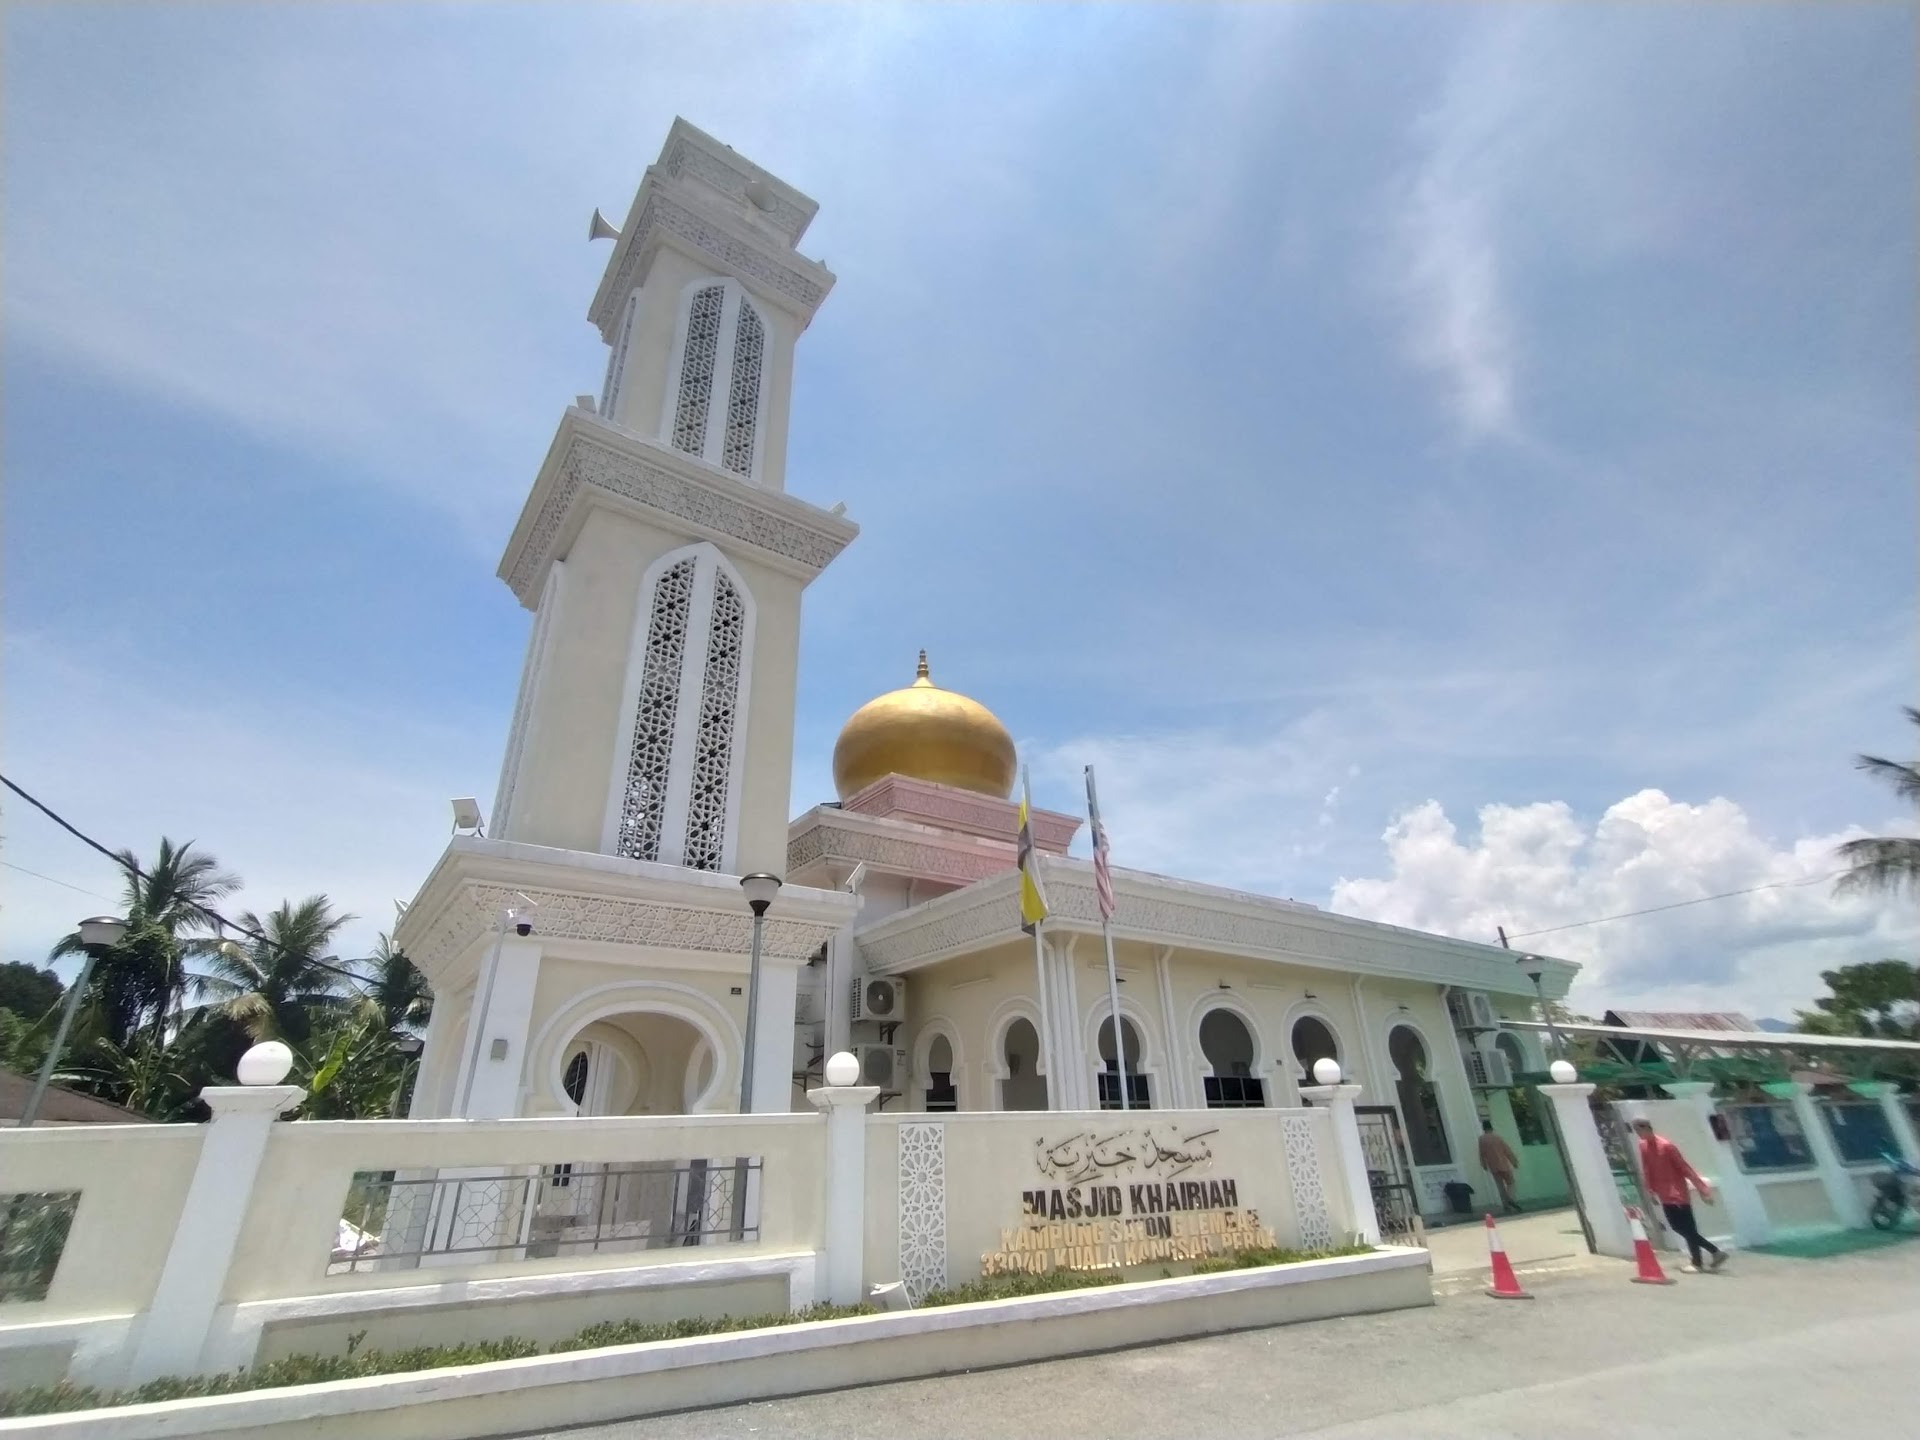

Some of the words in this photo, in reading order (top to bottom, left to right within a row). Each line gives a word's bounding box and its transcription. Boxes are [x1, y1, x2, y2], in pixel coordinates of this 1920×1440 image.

[1023, 1185, 1122, 1220] MASJID
[1130, 1179, 1238, 1214] KHAIRIAH
[1001, 1222, 1106, 1252] KAMPUNG
[1109, 1214, 1183, 1244] SAYONG
[1054, 1244, 1121, 1271] KUALA
[1124, 1234, 1214, 1266] KANGSAR
[1220, 1226, 1278, 1250] PERAK
